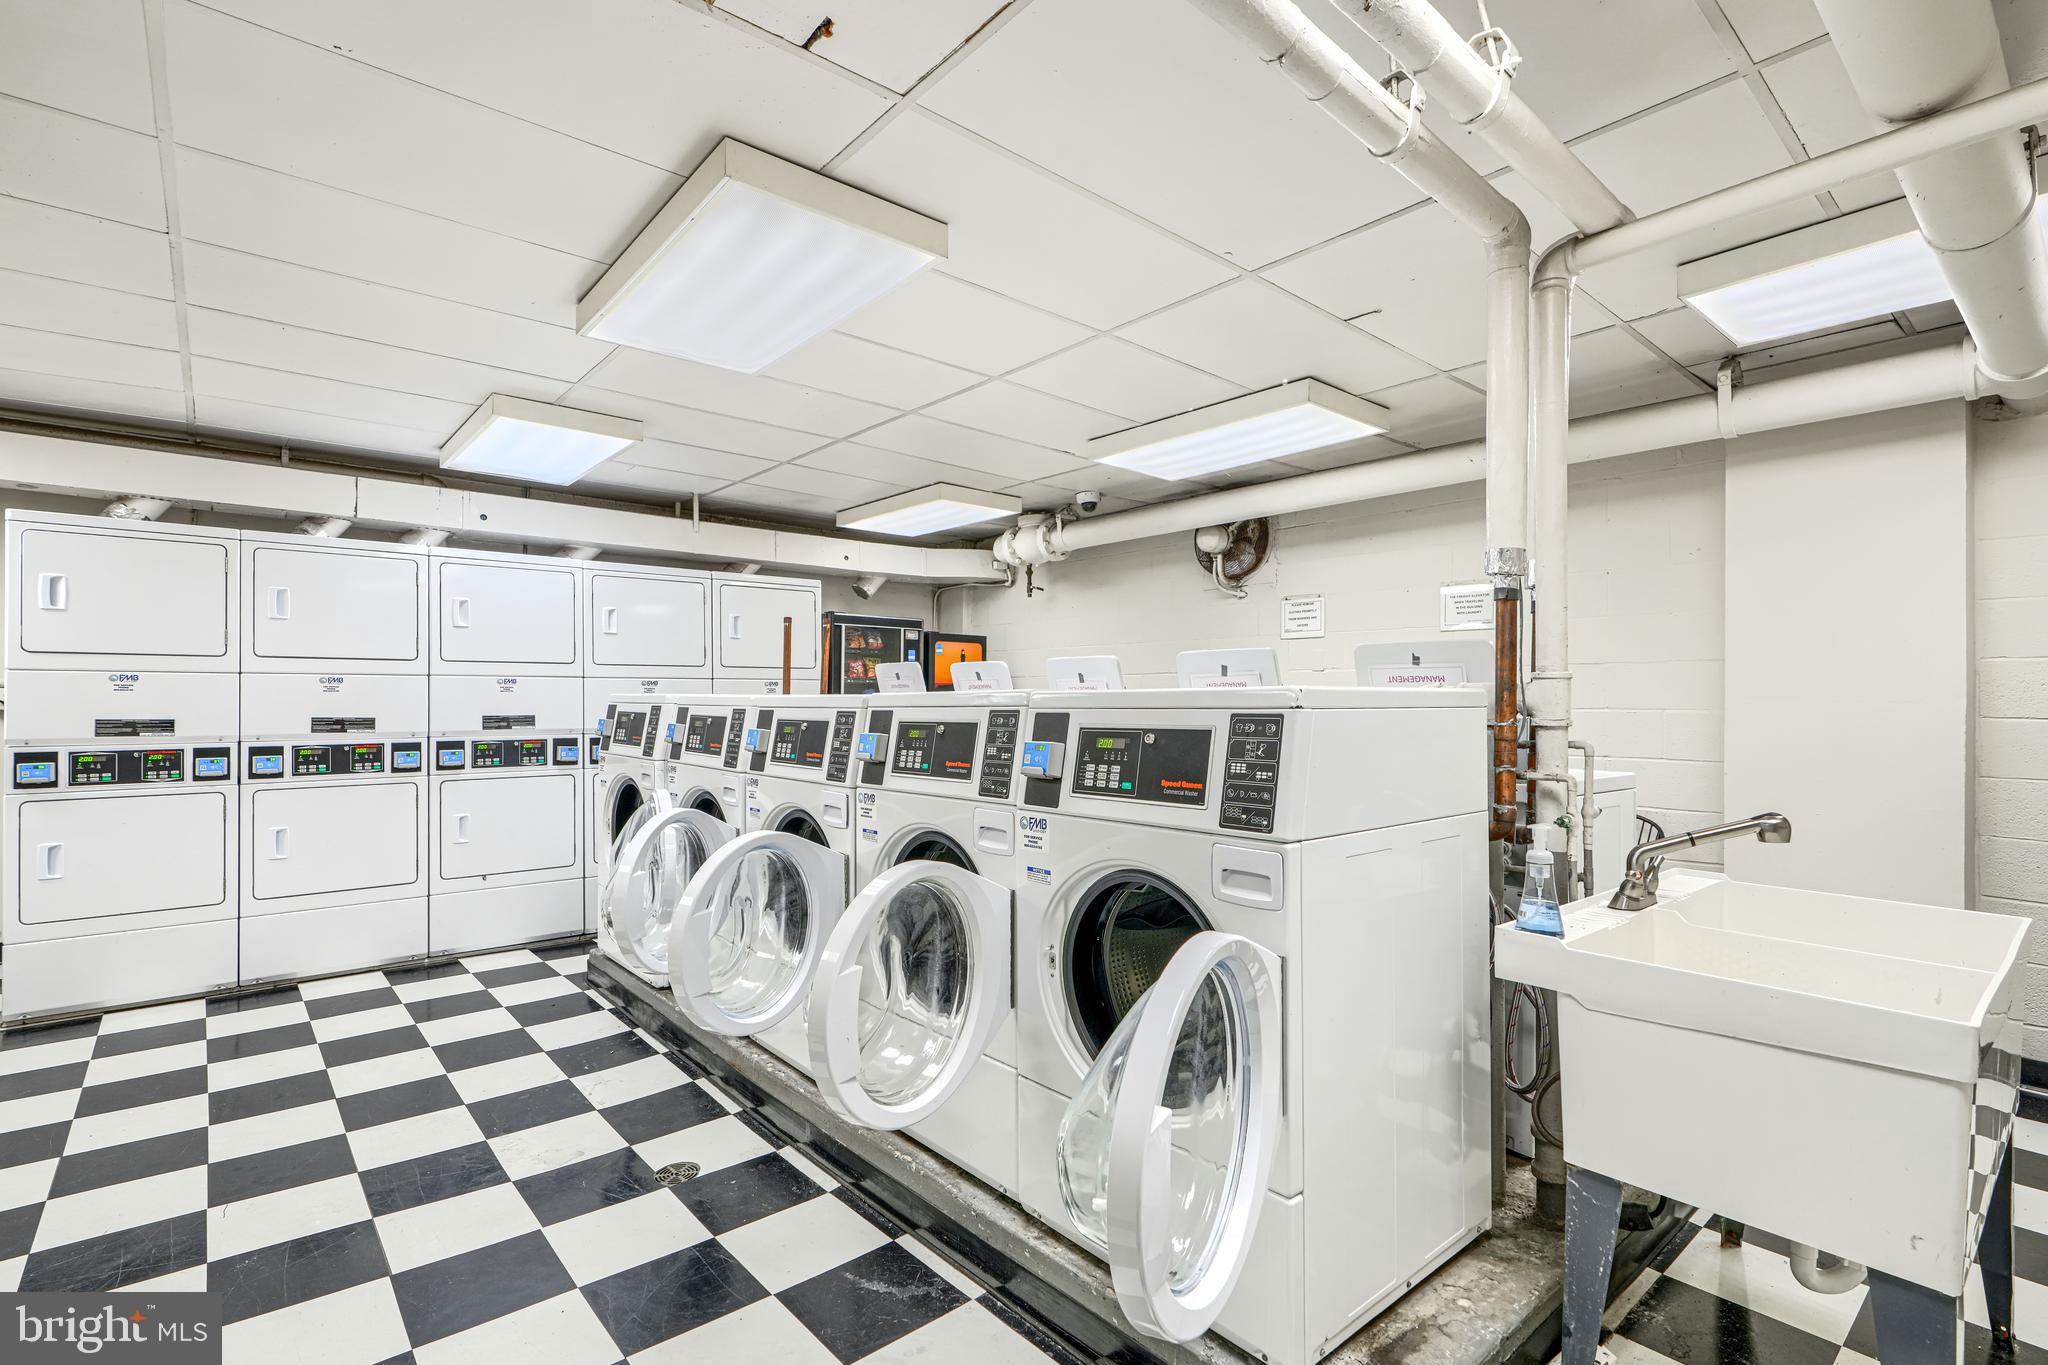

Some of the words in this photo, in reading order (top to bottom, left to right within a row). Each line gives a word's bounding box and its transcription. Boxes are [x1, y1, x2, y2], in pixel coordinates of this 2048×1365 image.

[1161, 780, 1181, 788] Speed
[1182, 781, 1203, 789] Queen
[1029, 817, 1047, 831] FMB
